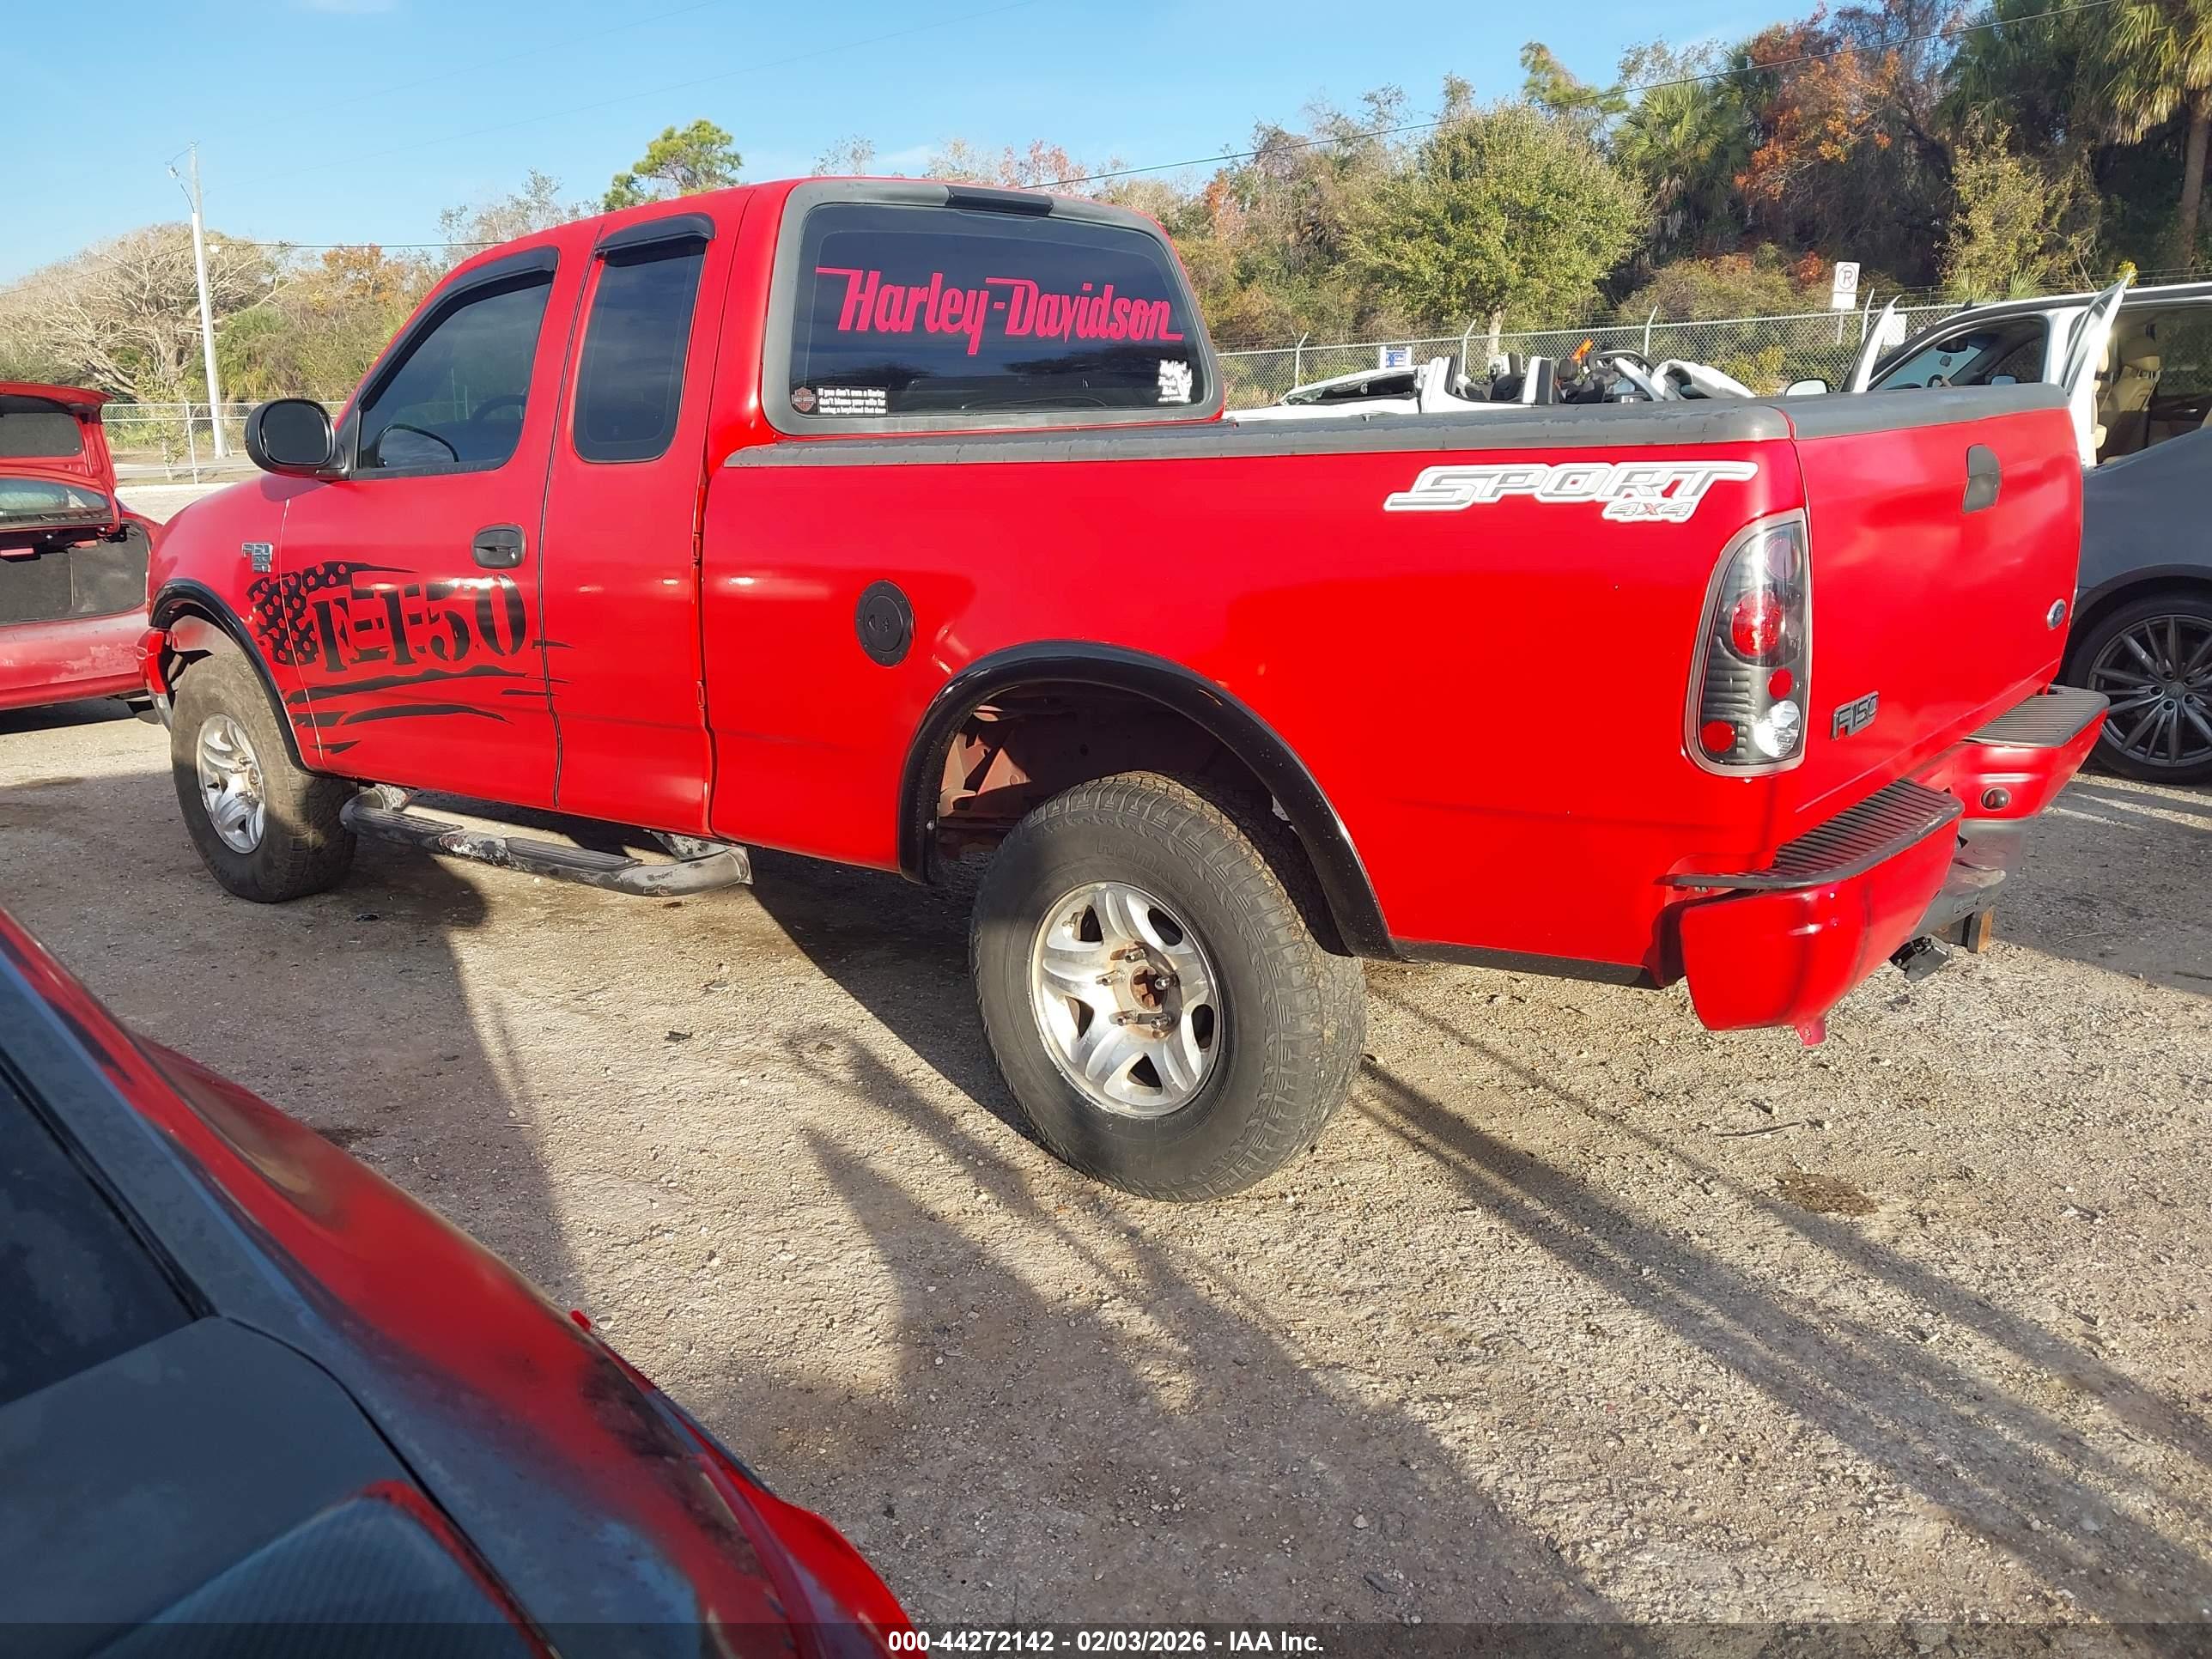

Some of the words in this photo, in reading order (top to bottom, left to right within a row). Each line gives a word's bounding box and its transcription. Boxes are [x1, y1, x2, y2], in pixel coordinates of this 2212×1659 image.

[816, 267, 1183, 356] Harley-Davidson
[1385, 463, 1758, 511] SPORT
[1605, 500, 1693, 520] 4x4
[1831, 690, 1879, 740] F150
